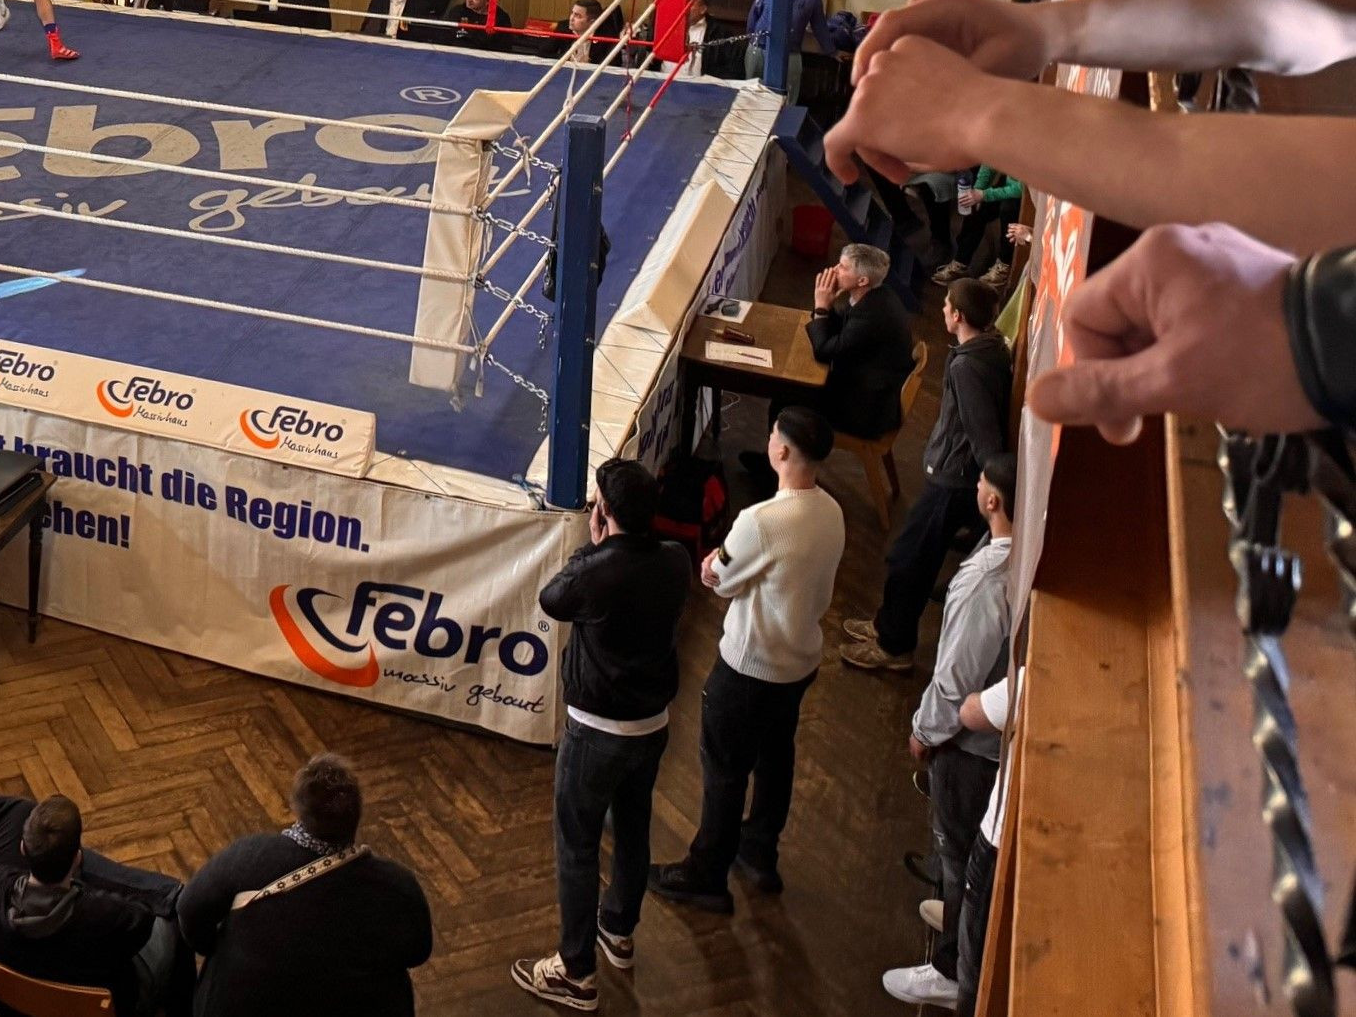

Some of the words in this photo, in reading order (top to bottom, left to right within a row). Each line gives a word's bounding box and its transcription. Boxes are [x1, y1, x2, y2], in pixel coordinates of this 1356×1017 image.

[189, 166, 532, 232] geba
[123, 376, 193, 410] Febro
[268, 406, 343, 442] Febro
[279, 436, 338, 459] Massivhaus
[14, 436, 153, 496] braucht
[161, 468, 217, 511] die
[225, 485, 370, 553] Region.
[346, 581, 548, 676] Febro
[383, 668, 456, 692] massiv
[466, 684, 545, 713] gebaut
